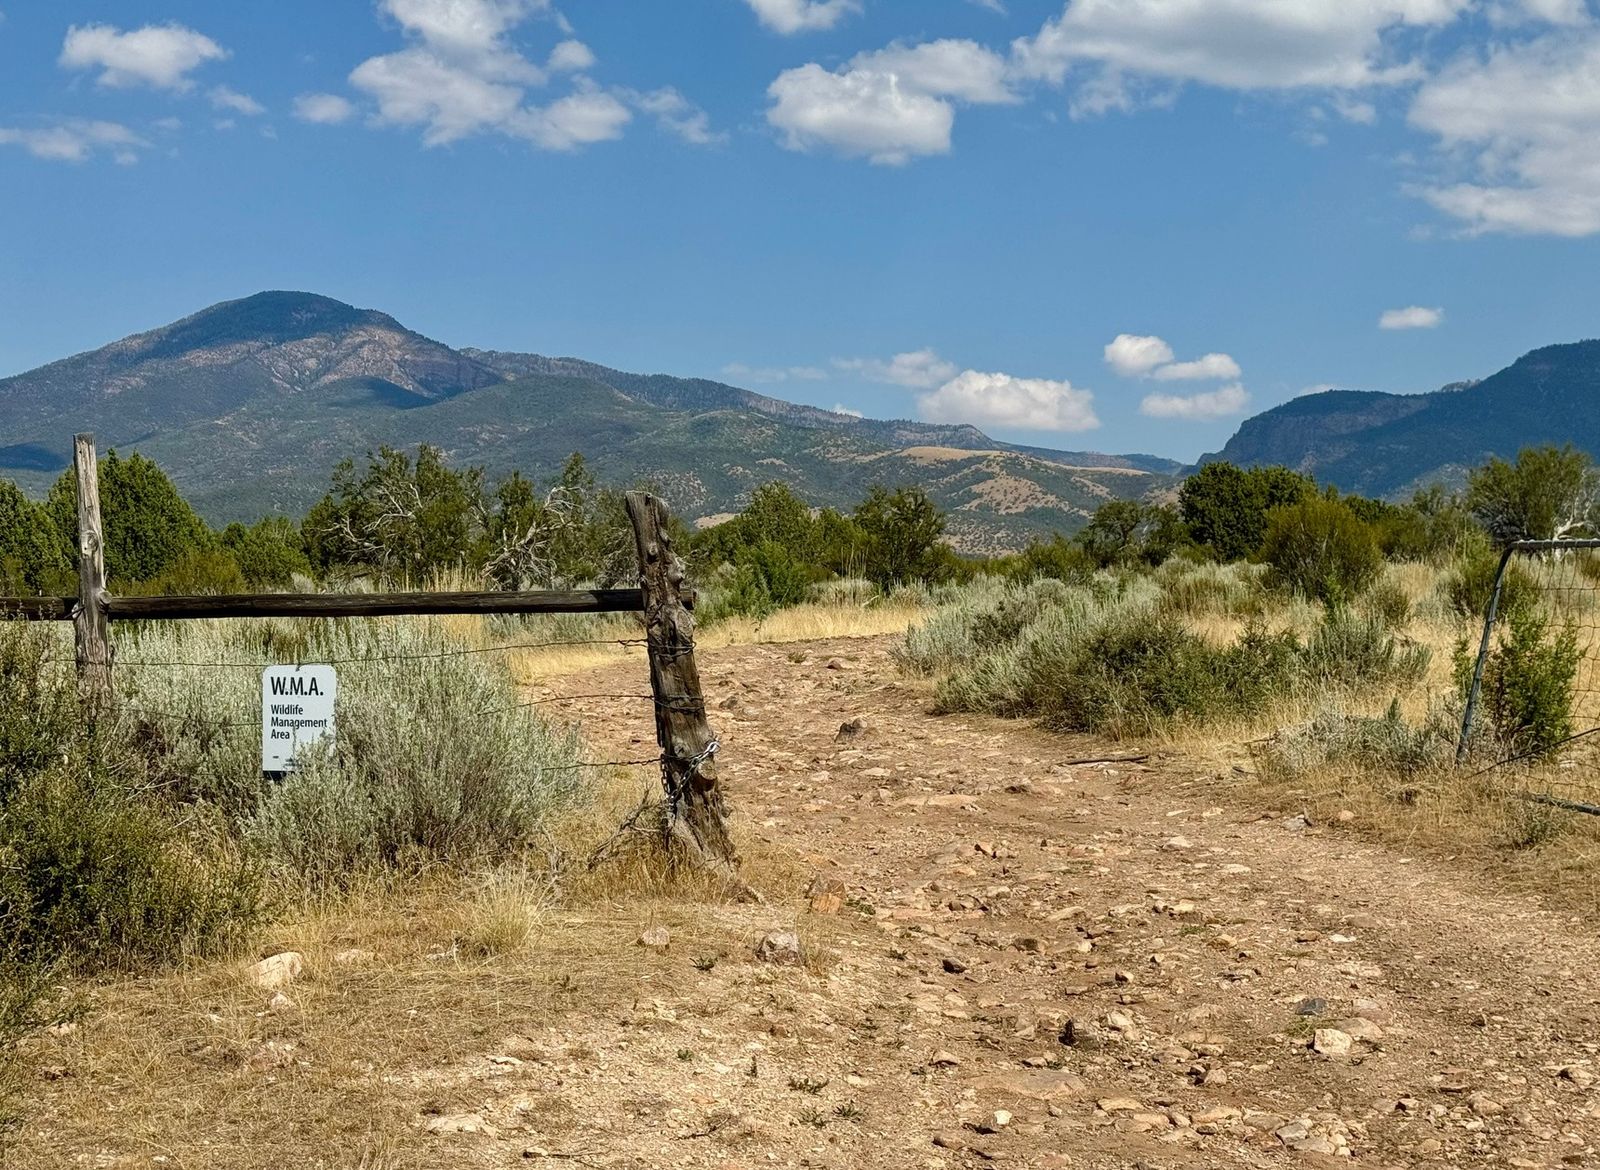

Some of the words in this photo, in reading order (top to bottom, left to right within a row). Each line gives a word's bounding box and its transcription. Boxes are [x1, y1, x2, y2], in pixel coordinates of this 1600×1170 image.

[270, 676, 324, 696] W.M.A.
[270, 704, 304, 715] Wildlife
[270, 716, 328, 729] Management
[270, 729, 290, 739] Area
